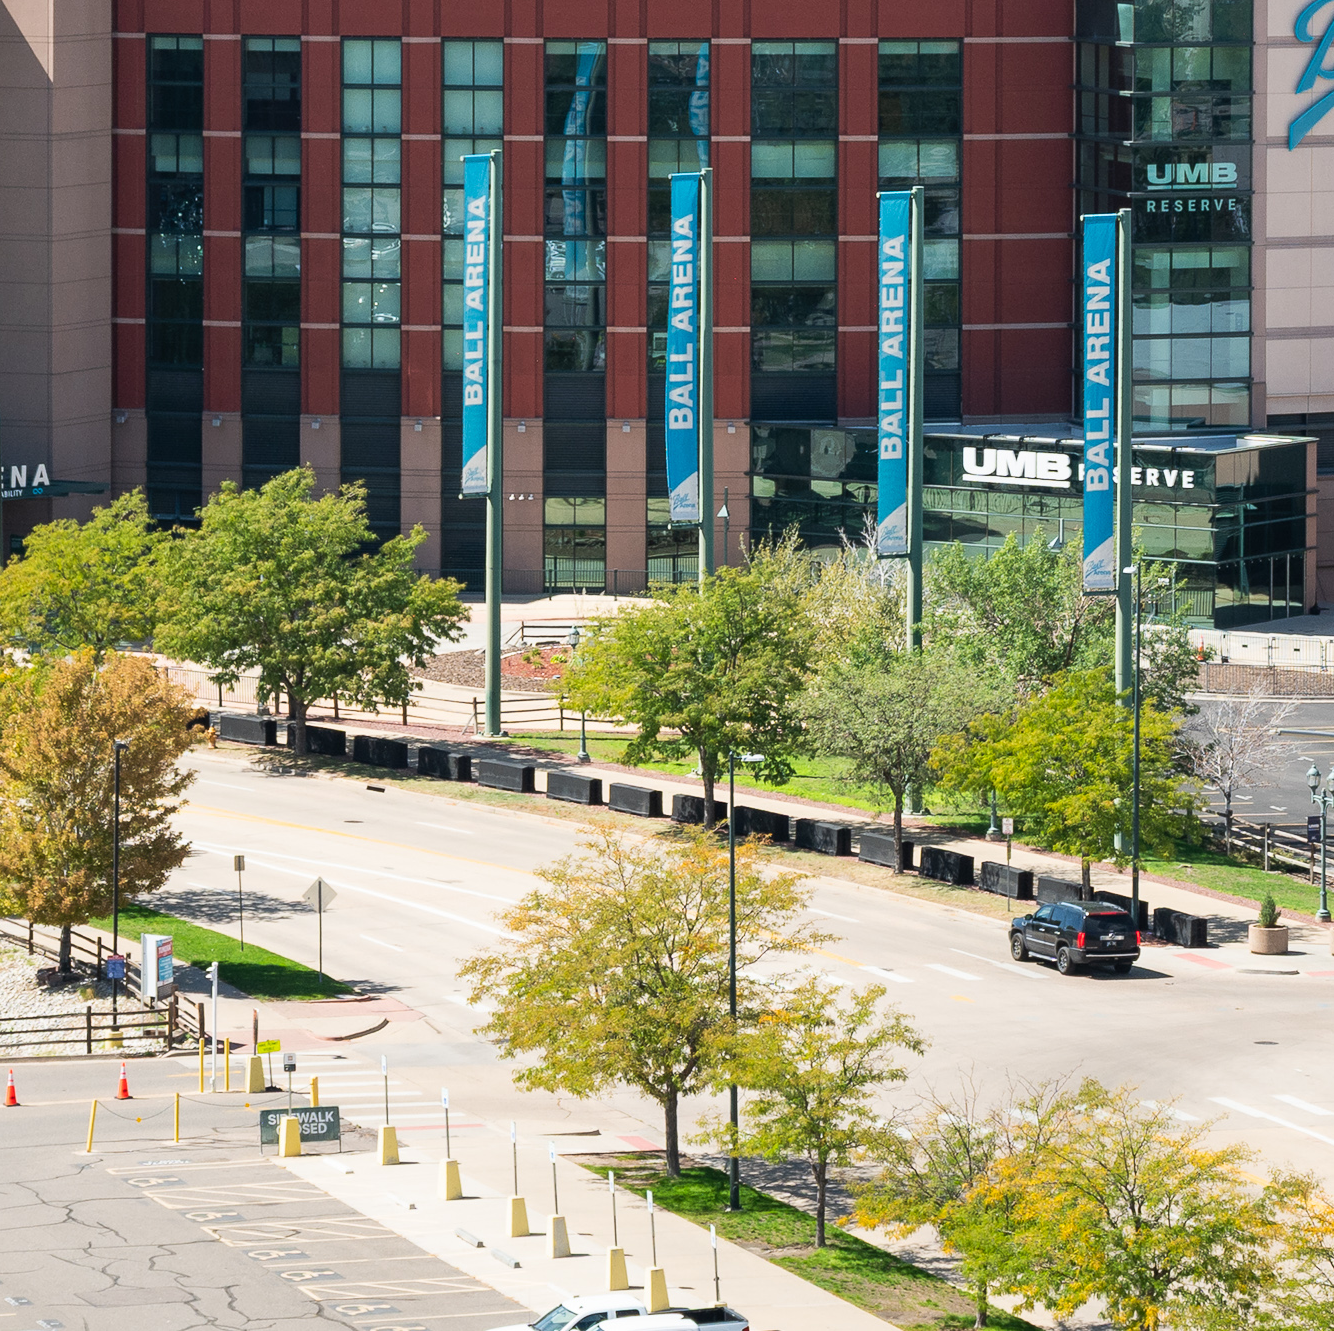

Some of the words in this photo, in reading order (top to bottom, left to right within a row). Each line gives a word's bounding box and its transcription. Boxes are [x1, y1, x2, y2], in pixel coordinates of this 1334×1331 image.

[1147, 162, 1238, 184] UMB
[1147, 198, 1236, 212] RESERVE
[465, 194, 487, 312] ARENA
[671, 213, 694, 333] ARENA
[880, 234, 905, 358] ARENA
[464, 320, 484, 407] BALL
[1086, 257, 1111, 388] ARENA
[668, 342, 694, 430] BALL
[880, 369, 903, 460] BALL
[962, 446, 1072, 481] UMB
[1078, 463, 1195, 489] SERVE
[1085, 397, 1110, 493] BALL
[268, 1111, 334, 1125] SIWALK
[276, 1123, 327, 1135] SED
